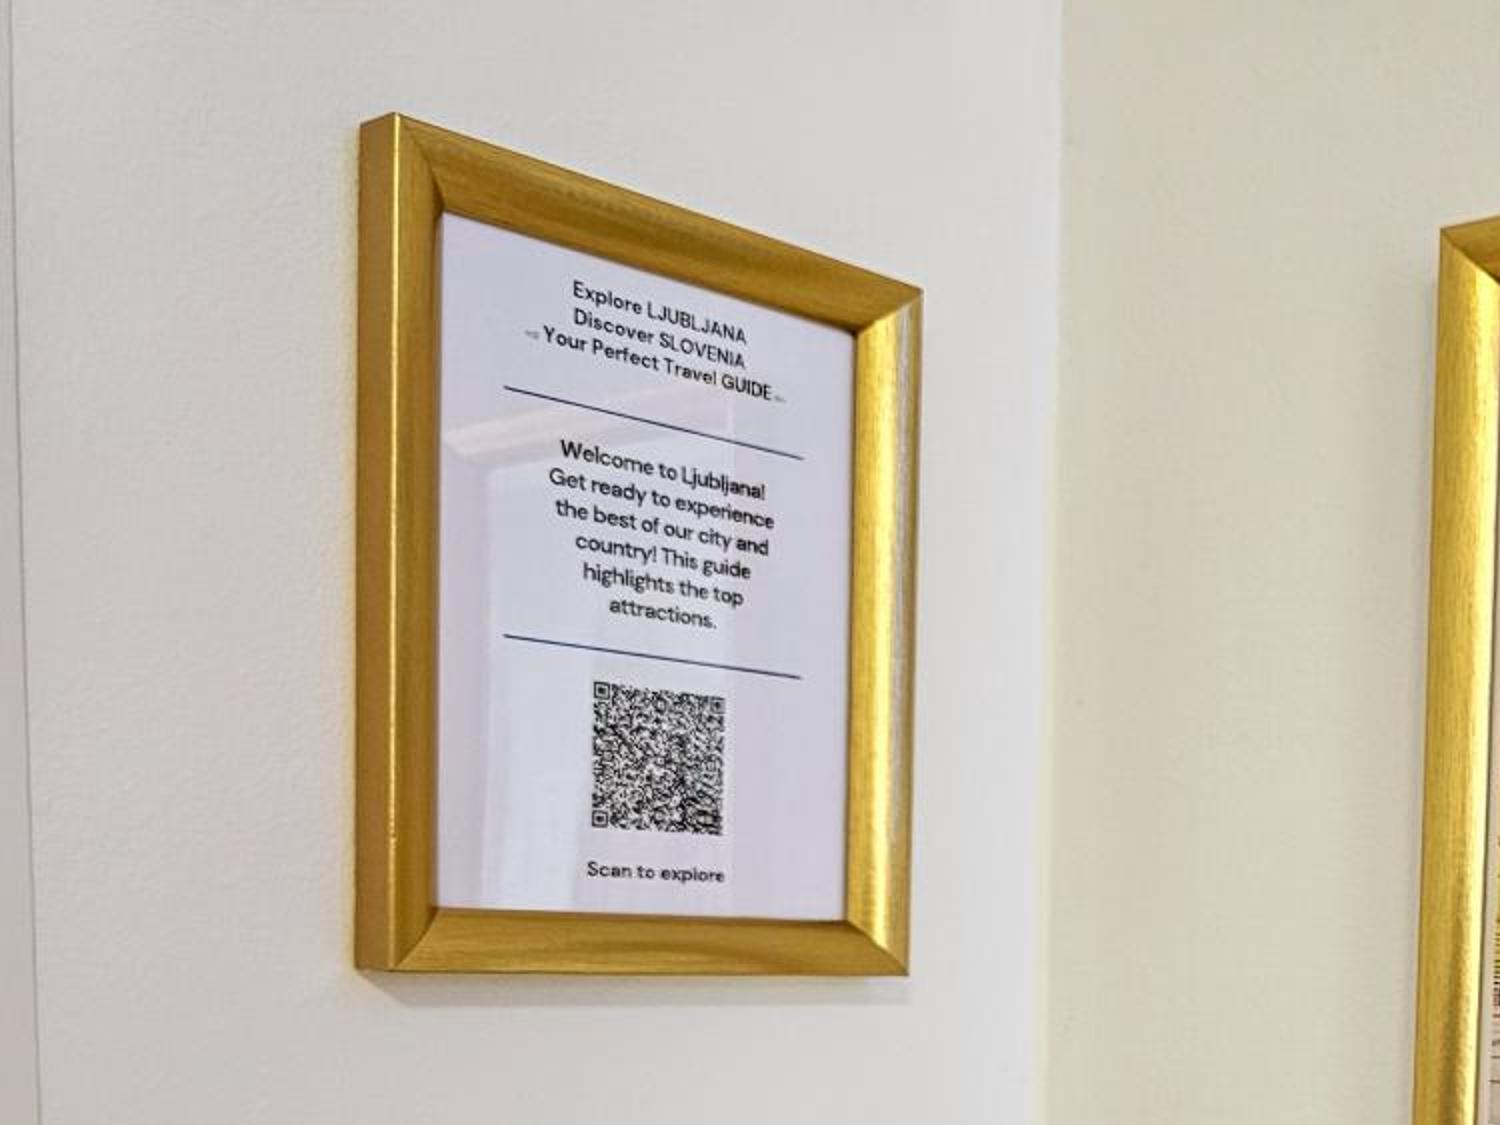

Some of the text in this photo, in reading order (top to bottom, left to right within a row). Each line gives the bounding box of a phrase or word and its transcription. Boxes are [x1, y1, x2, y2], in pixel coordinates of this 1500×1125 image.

[572, 279, 747, 345] Explore LJUBLJANA
[573, 306, 746, 370] Discover SLOVENIA
[543, 324, 772, 401] Your Perfect Travel GUIDE
[549, 467, 775, 530] Get ready to experience
[560, 439, 766, 501] Welcome to Ljubljana!
[555, 500, 769, 557] the best of our city and
[575, 535, 751, 581] country! This guide
[582, 561, 744, 608] highlights the top
[609, 597, 718, 630] attractions.
[587, 861, 726, 884] Scan to explore
